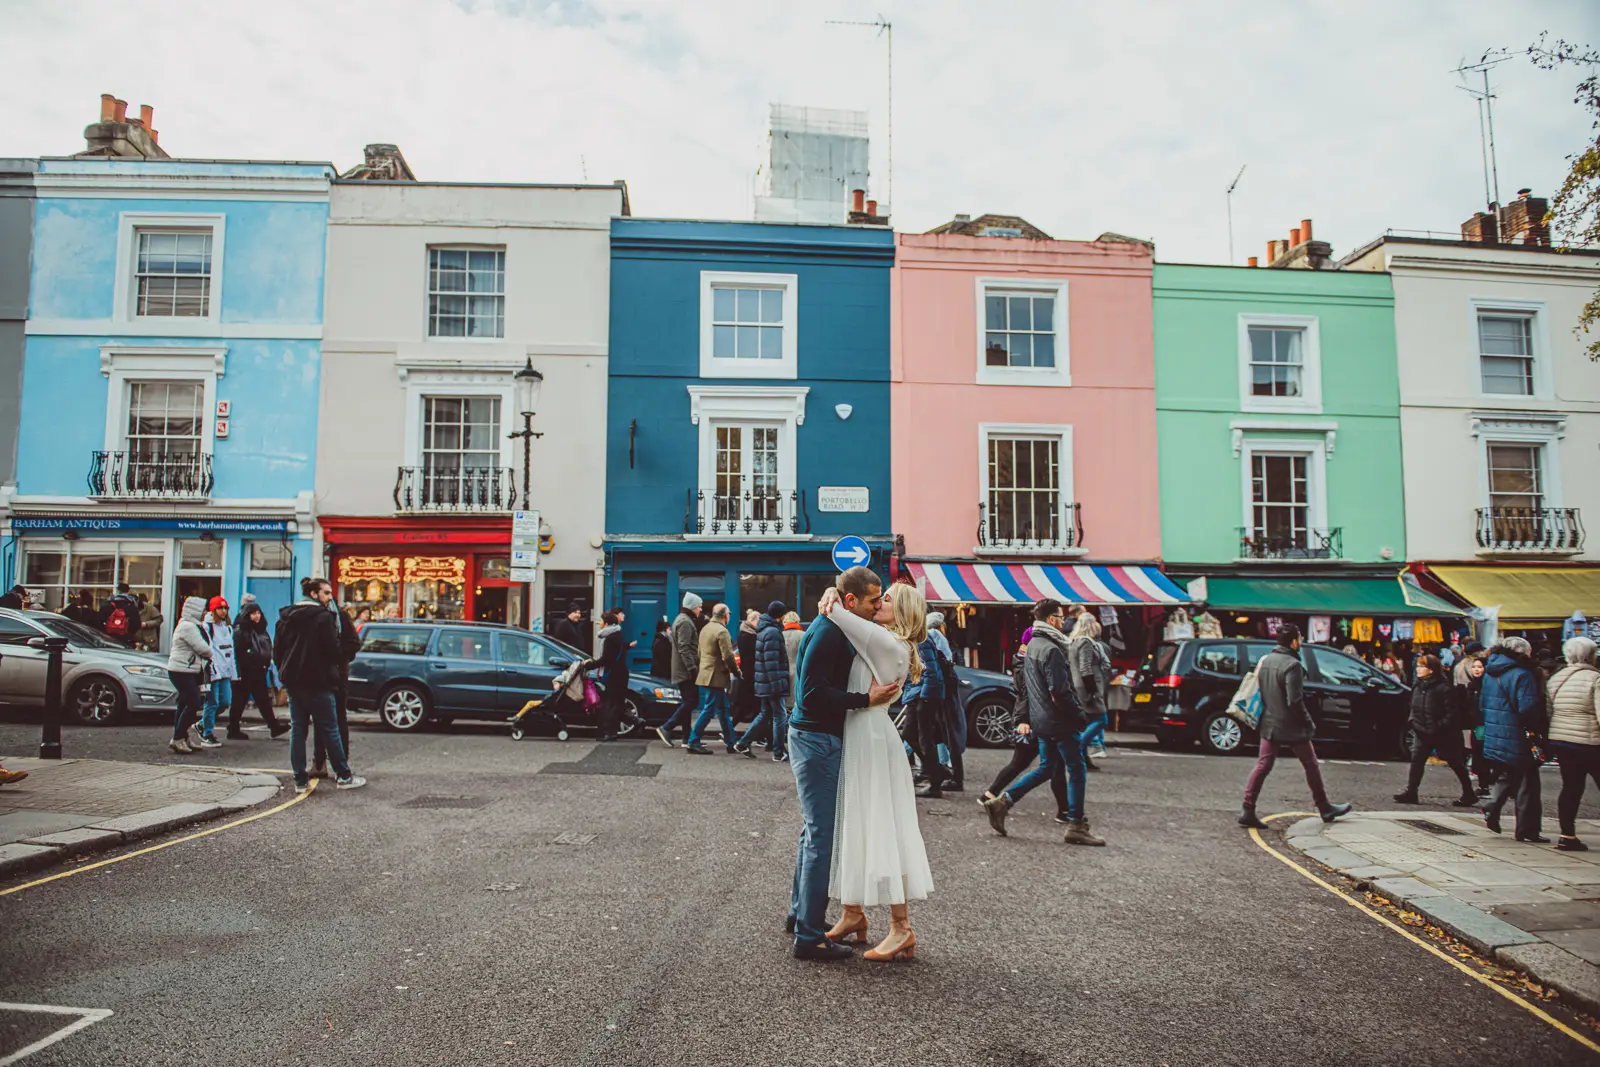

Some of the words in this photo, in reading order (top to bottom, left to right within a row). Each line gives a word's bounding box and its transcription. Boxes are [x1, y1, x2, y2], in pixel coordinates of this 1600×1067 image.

[14, 519, 63, 528] BARHAM
[65, 519, 121, 529] ANTIQUES
[177, 521, 284, 531] www.barhamantiques.co.uk
